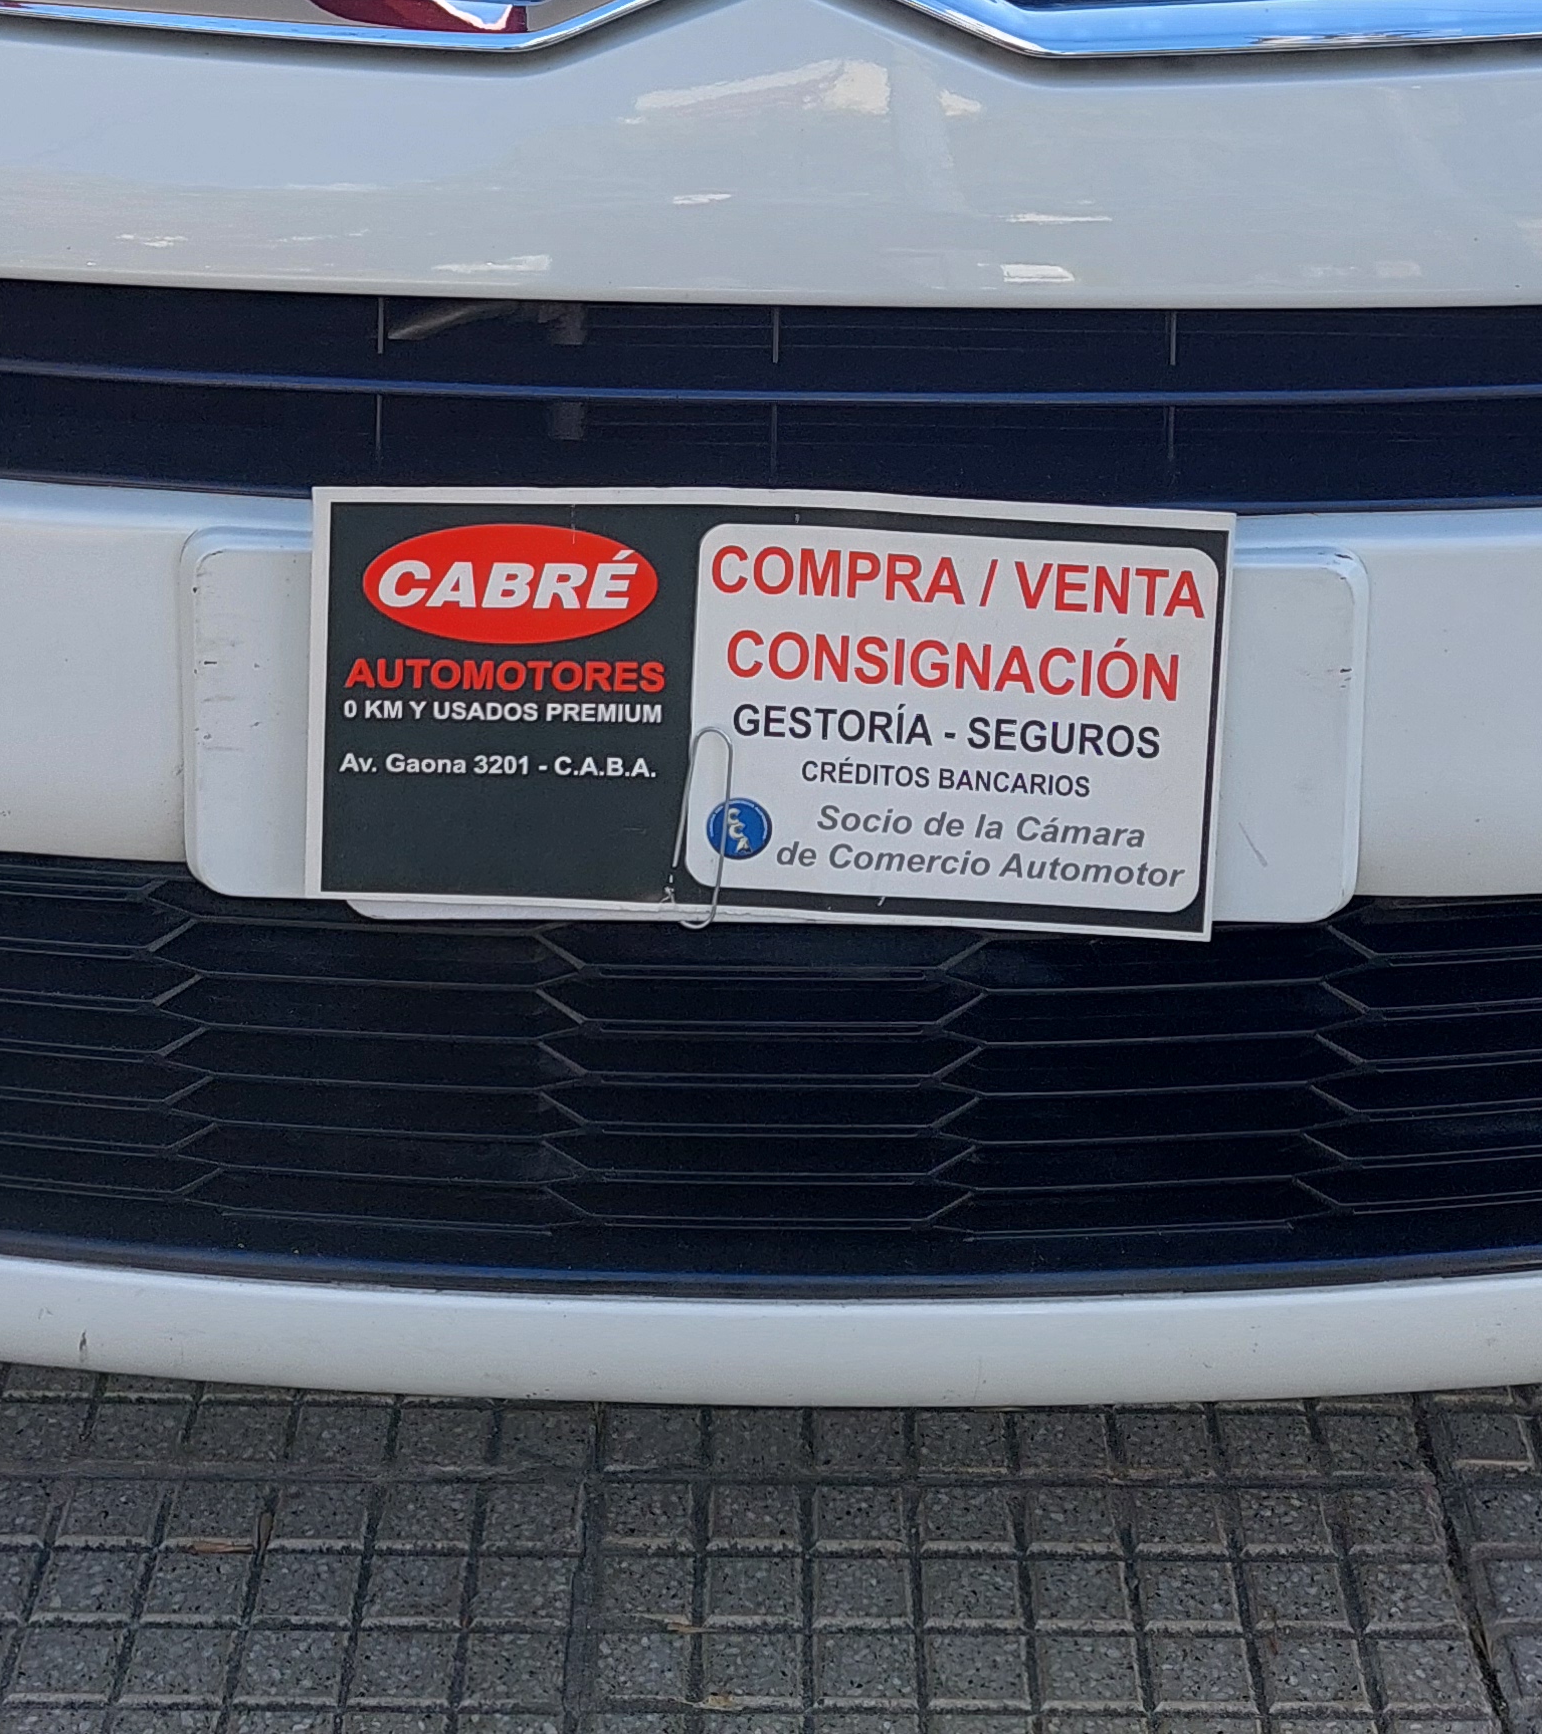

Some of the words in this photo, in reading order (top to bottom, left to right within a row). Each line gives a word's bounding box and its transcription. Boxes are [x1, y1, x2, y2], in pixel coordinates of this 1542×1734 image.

[378, 550, 638, 609] CABRÉ
[712, 545, 965, 605] COMPRA
[979, 559, 998, 607] /
[1014, 560, 1206, 619] VENTA
[345, 658, 666, 693] AUTOMOTORES
[727, 629, 1179, 701] CONSIGNACIÓN
[343, 699, 357, 718] 0
[365, 700, 403, 719] KM
[409, 701, 427, 720] Y
[433, 702, 538, 722] USADOS
[546, 703, 662, 723] PREMIUM
[733, 703, 933, 746] GESTORÍA
[966, 716, 1160, 759] SEGUROS
[339, 752, 378, 773] Av.
[385, 754, 466, 774] Gaona
[473, 755, 529, 775] 3201
[554, 756, 657, 778] C.A.B.A.
[801, 756, 930, 789] CRÉDITOS
[938, 768, 1090, 798] BANCARIOS
[817, 803, 912, 835] Socio
[923, 810, 965, 837] de
[974, 812, 1004, 840] la
[1016, 815, 1146, 849] Cámara
[776, 840, 817, 867] de
[827, 842, 990, 876] Comercio
[999, 852, 1185, 888] Automotor
